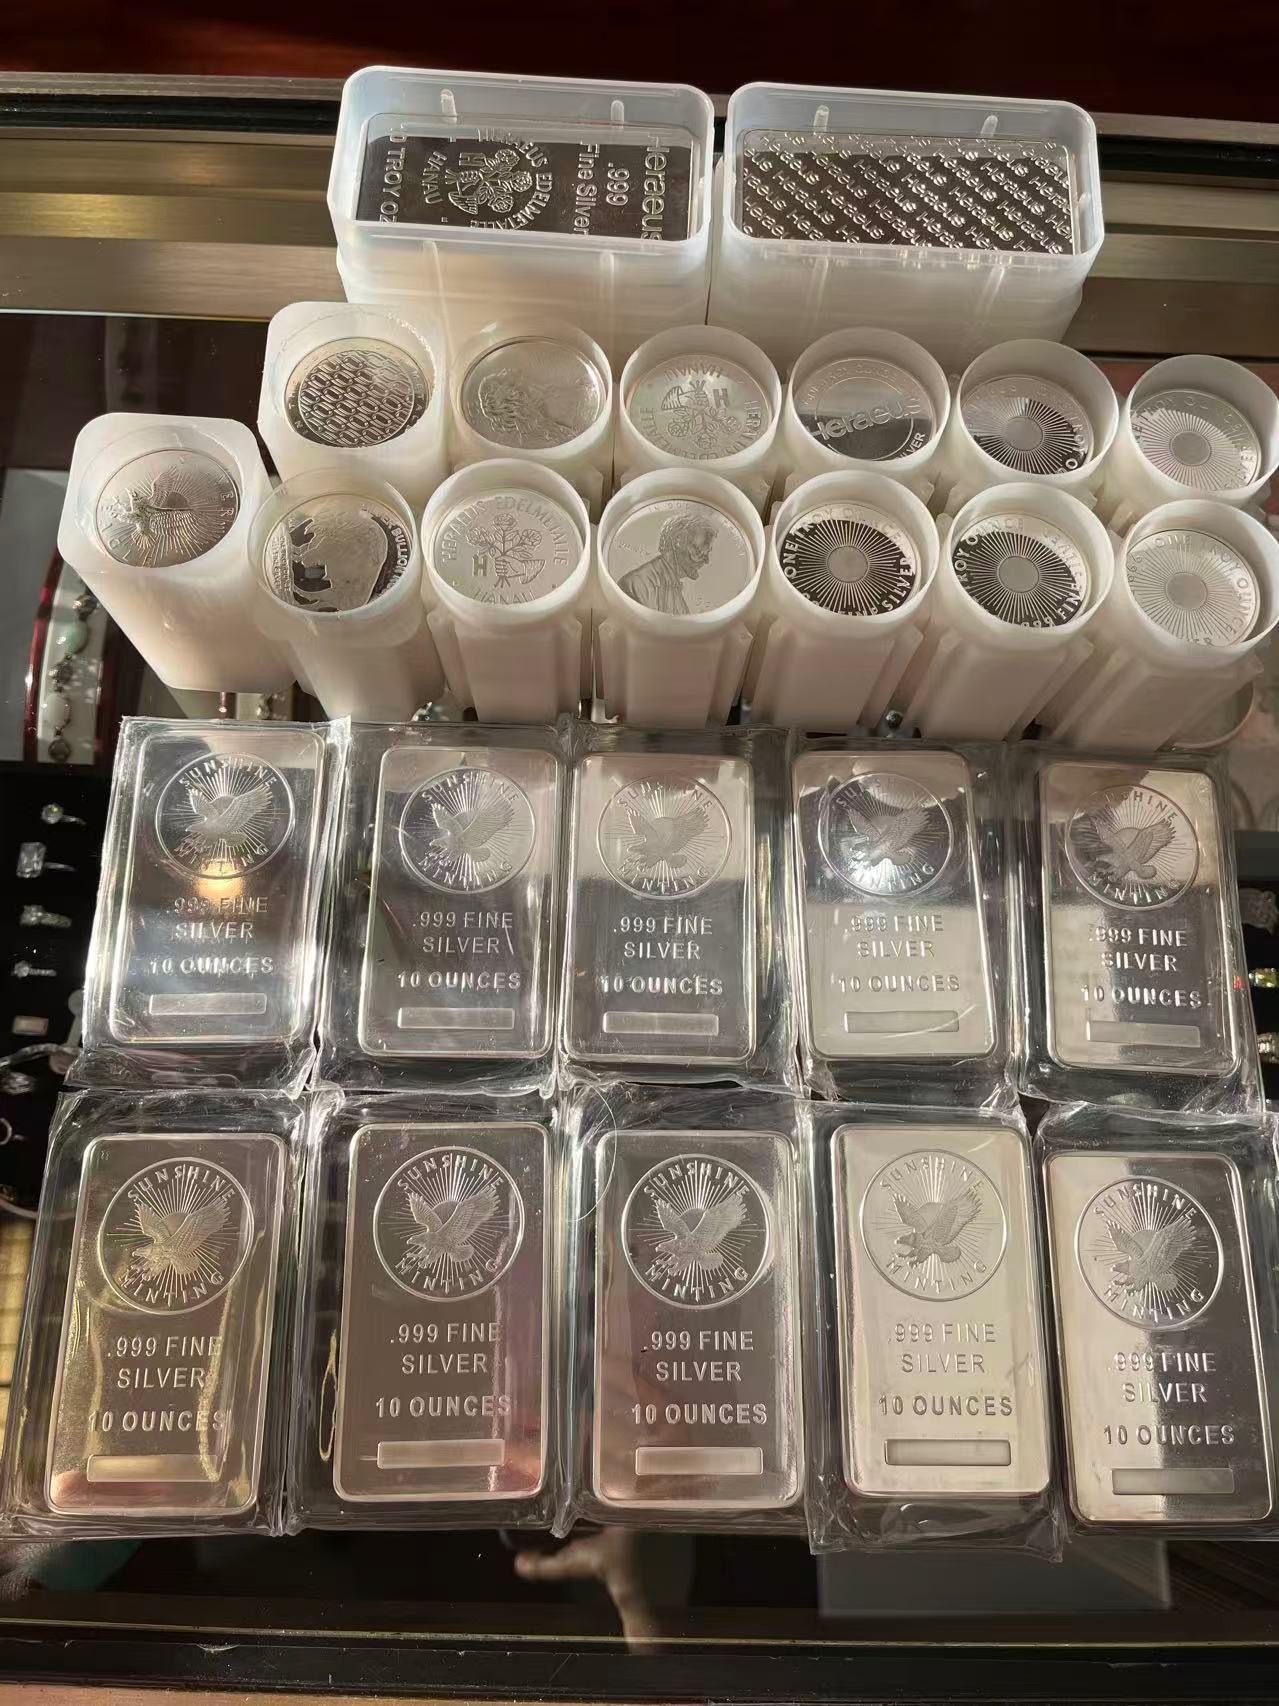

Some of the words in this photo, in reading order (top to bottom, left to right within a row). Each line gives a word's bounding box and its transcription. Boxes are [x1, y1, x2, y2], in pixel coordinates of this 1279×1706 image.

[383, 147, 407, 198] TROY
[421, 151, 448, 205] HANAU
[605, 161, 631, 207] .999
[772, 170, 836, 225] Heraeus
[852, 159, 917, 214] Heraeus
[980, 161, 1046, 216] Heraeus
[573, 182, 598, 236] Silver
[819, 185, 885, 239] Heraeus
[901, 173, 966, 228] Heraeus
[948, 186, 1014, 241] Heraeus
[783, 540, 799, 579] ONE
[881, 556, 914, 602] SILVER
[217, 896, 270, 915] FINE
[174, 920, 255, 941] SILVER
[411, 911, 457, 929] .999
[463, 911, 514, 930] FINE
[613, 916, 657, 935] .999
[662, 916, 714, 936] FINE
[893, 914, 945, 932] FINE
[422, 936, 501, 954] SILVER
[1088, 926, 1133, 944] .999
[1138, 927, 1189, 947] FINE
[623, 941, 701, 961] SILVER
[856, 940, 936, 959] SILVER
[149, 956, 174, 975] 10
[180, 955, 275, 977] OUNCES
[1101, 952, 1178, 972] SILVER
[397, 970, 421, 989] 10
[428, 970, 522, 991] OUNCES
[599, 975, 624, 994] 10
[630, 975, 724, 996] OUNCES
[836, 974, 862, 993] 10
[868, 974, 961, 993] OUNCES
[1080, 984, 1105, 1003] 10
[1111, 985, 1202, 1009] OUNCES
[126, 1164, 237, 1203] SUNSHINE
[396, 1154, 505, 1192] SUNSHINE
[643, 1161, 751, 1198] SUNSHINE
[879, 1157, 985, 1193] SUNSHINE
[1093, 1182, 1199, 1220] SUNSHINE
[886, 1257, 989, 1295] MINTING
[1103, 1287, 1205, 1324] MINTING
[389, 1323, 439, 1344] .999
[447, 1322, 502, 1344] FINE
[643, 1331, 691, 1352] .999
[699, 1330, 754, 1352] FINE
[887, 1323, 934, 1344] .999
[942, 1323, 997, 1343] FINE
[107, 1337, 157, 1358] .999
[165, 1335, 224, 1357] FINE
[401, 1353, 489, 1375] SILVER
[655, 1360, 743, 1383] SILVER
[901, 1353, 986, 1374] SILVER
[1107, 1352, 1155, 1373] .999
[1161, 1351, 1218, 1373] FINE
[117, 1367, 206, 1390] SILVER
[1121, 1382, 1209, 1404] SILVER
[374, 1397, 401, 1419] 10
[409, 1395, 512, 1418] OUNCES
[631, 1402, 658, 1425] 10
[664, 1402, 768, 1426] OUNCES
[878, 1395, 905, 1417] 10
[912, 1394, 1014, 1417] OUNCES
[87, 1410, 115, 1433] 10
[121, 1410, 226, 1433] OUNCES
[1103, 1424, 1129, 1446] 10
[1136, 1424, 1236, 1446] OUNCES
